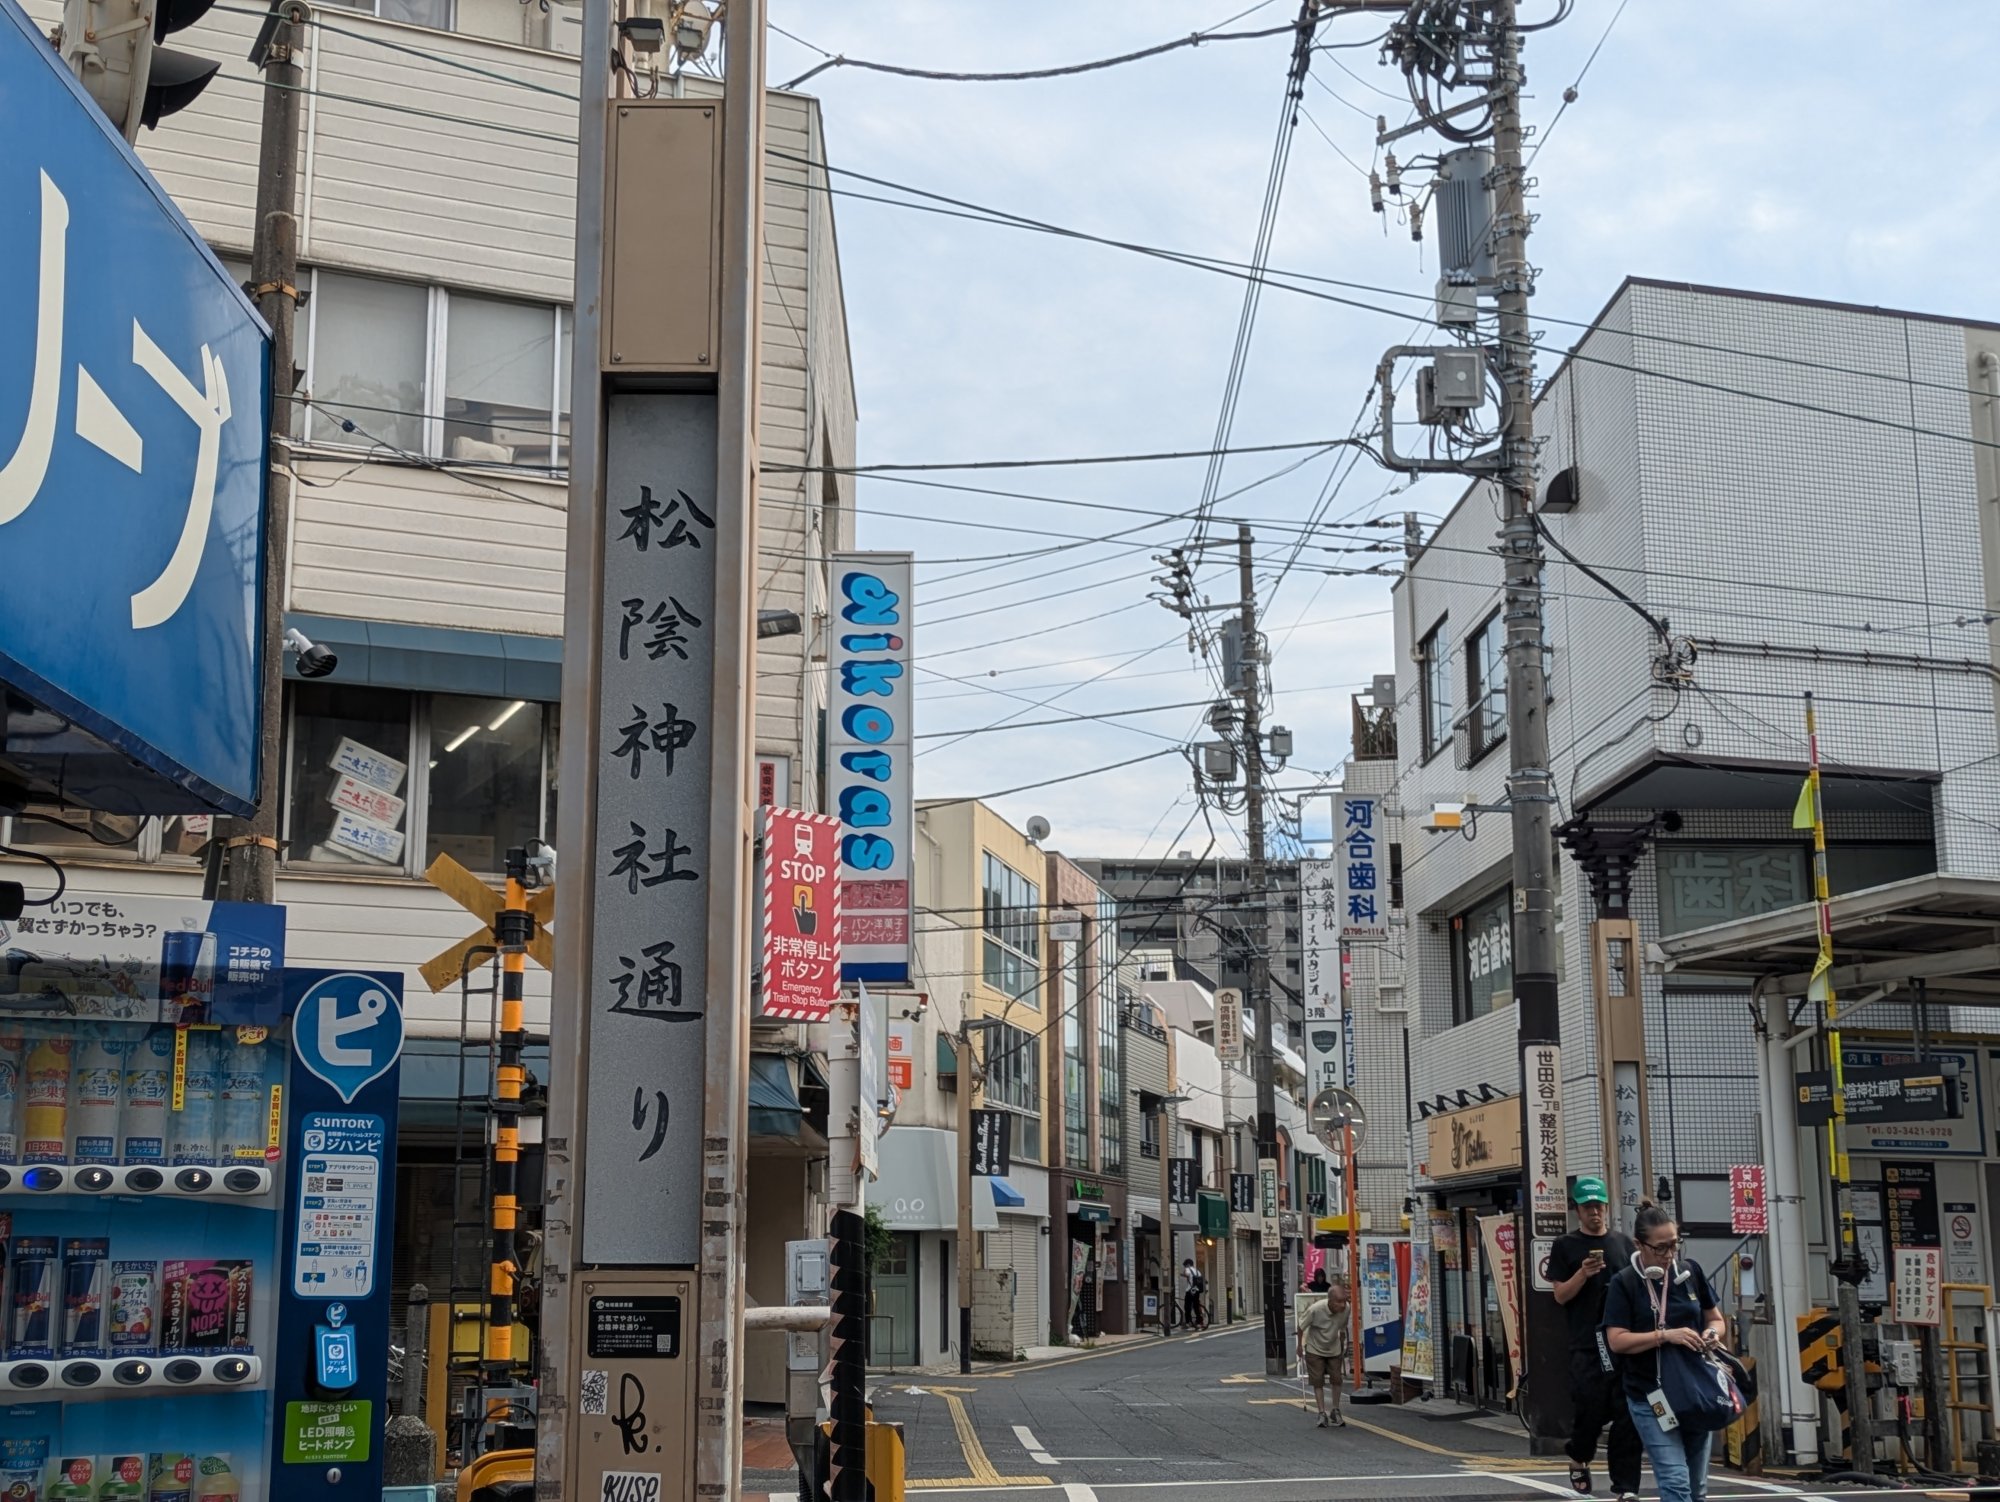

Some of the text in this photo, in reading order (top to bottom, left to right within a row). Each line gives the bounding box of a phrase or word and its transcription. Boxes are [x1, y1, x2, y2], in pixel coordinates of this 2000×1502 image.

[607, 485, 716, 1162] 松陰神社通り
[1344, 800, 1378, 924] 河合歯科
[781, 859, 826, 883] STOP
[1669, 850, 1797, 923] 歯科
[51, 901, 126, 918] いつでも、
[18, 916, 157, 939] 翼さずかっちゃう?
[852, 919, 903, 930] パン・洋菓子
[852, 930, 903, 942] サンドイッチ
[229, 946, 271, 958] コチラの
[773, 935, 832, 962] 非常停止
[228, 959, 271, 971] 自販機で
[781, 960, 824, 980] ボタン
[228, 971, 265, 983] 販売中!
[781, 981, 823, 997] Emergency
[773, 992, 791, 1004] Train
[791, 994, 809, 1008] Stop
[1307, 1008, 1326, 1018] 3階
[318, 989, 388, 1067] ピ
[314, 1117, 375, 1129] SUNTORY
[1866, 1126, 1884, 1135] Tel.
[326, 1138, 382, 1153] ジハンピ
[1736, 1181, 1759, 1189] STOP
[1735, 1206, 1763, 1214] 非常停止
[1739, 1213, 1760, 1221] ボタン
[234, 1271, 247, 1335] スカッと濃厚
[169, 1281, 182, 1348] やみつきフルーツ
[191, 1312, 225, 1333] NOPE
[597, 1323, 640, 1331] 松陰神社通り
[326, 1366, 349, 1375] タッチ
[301, 1404, 358, 1414] 地球にやさしい
[299, 1426, 356, 1438] LED照明&
[298, 1438, 356, 1451] ヒートポンプ
